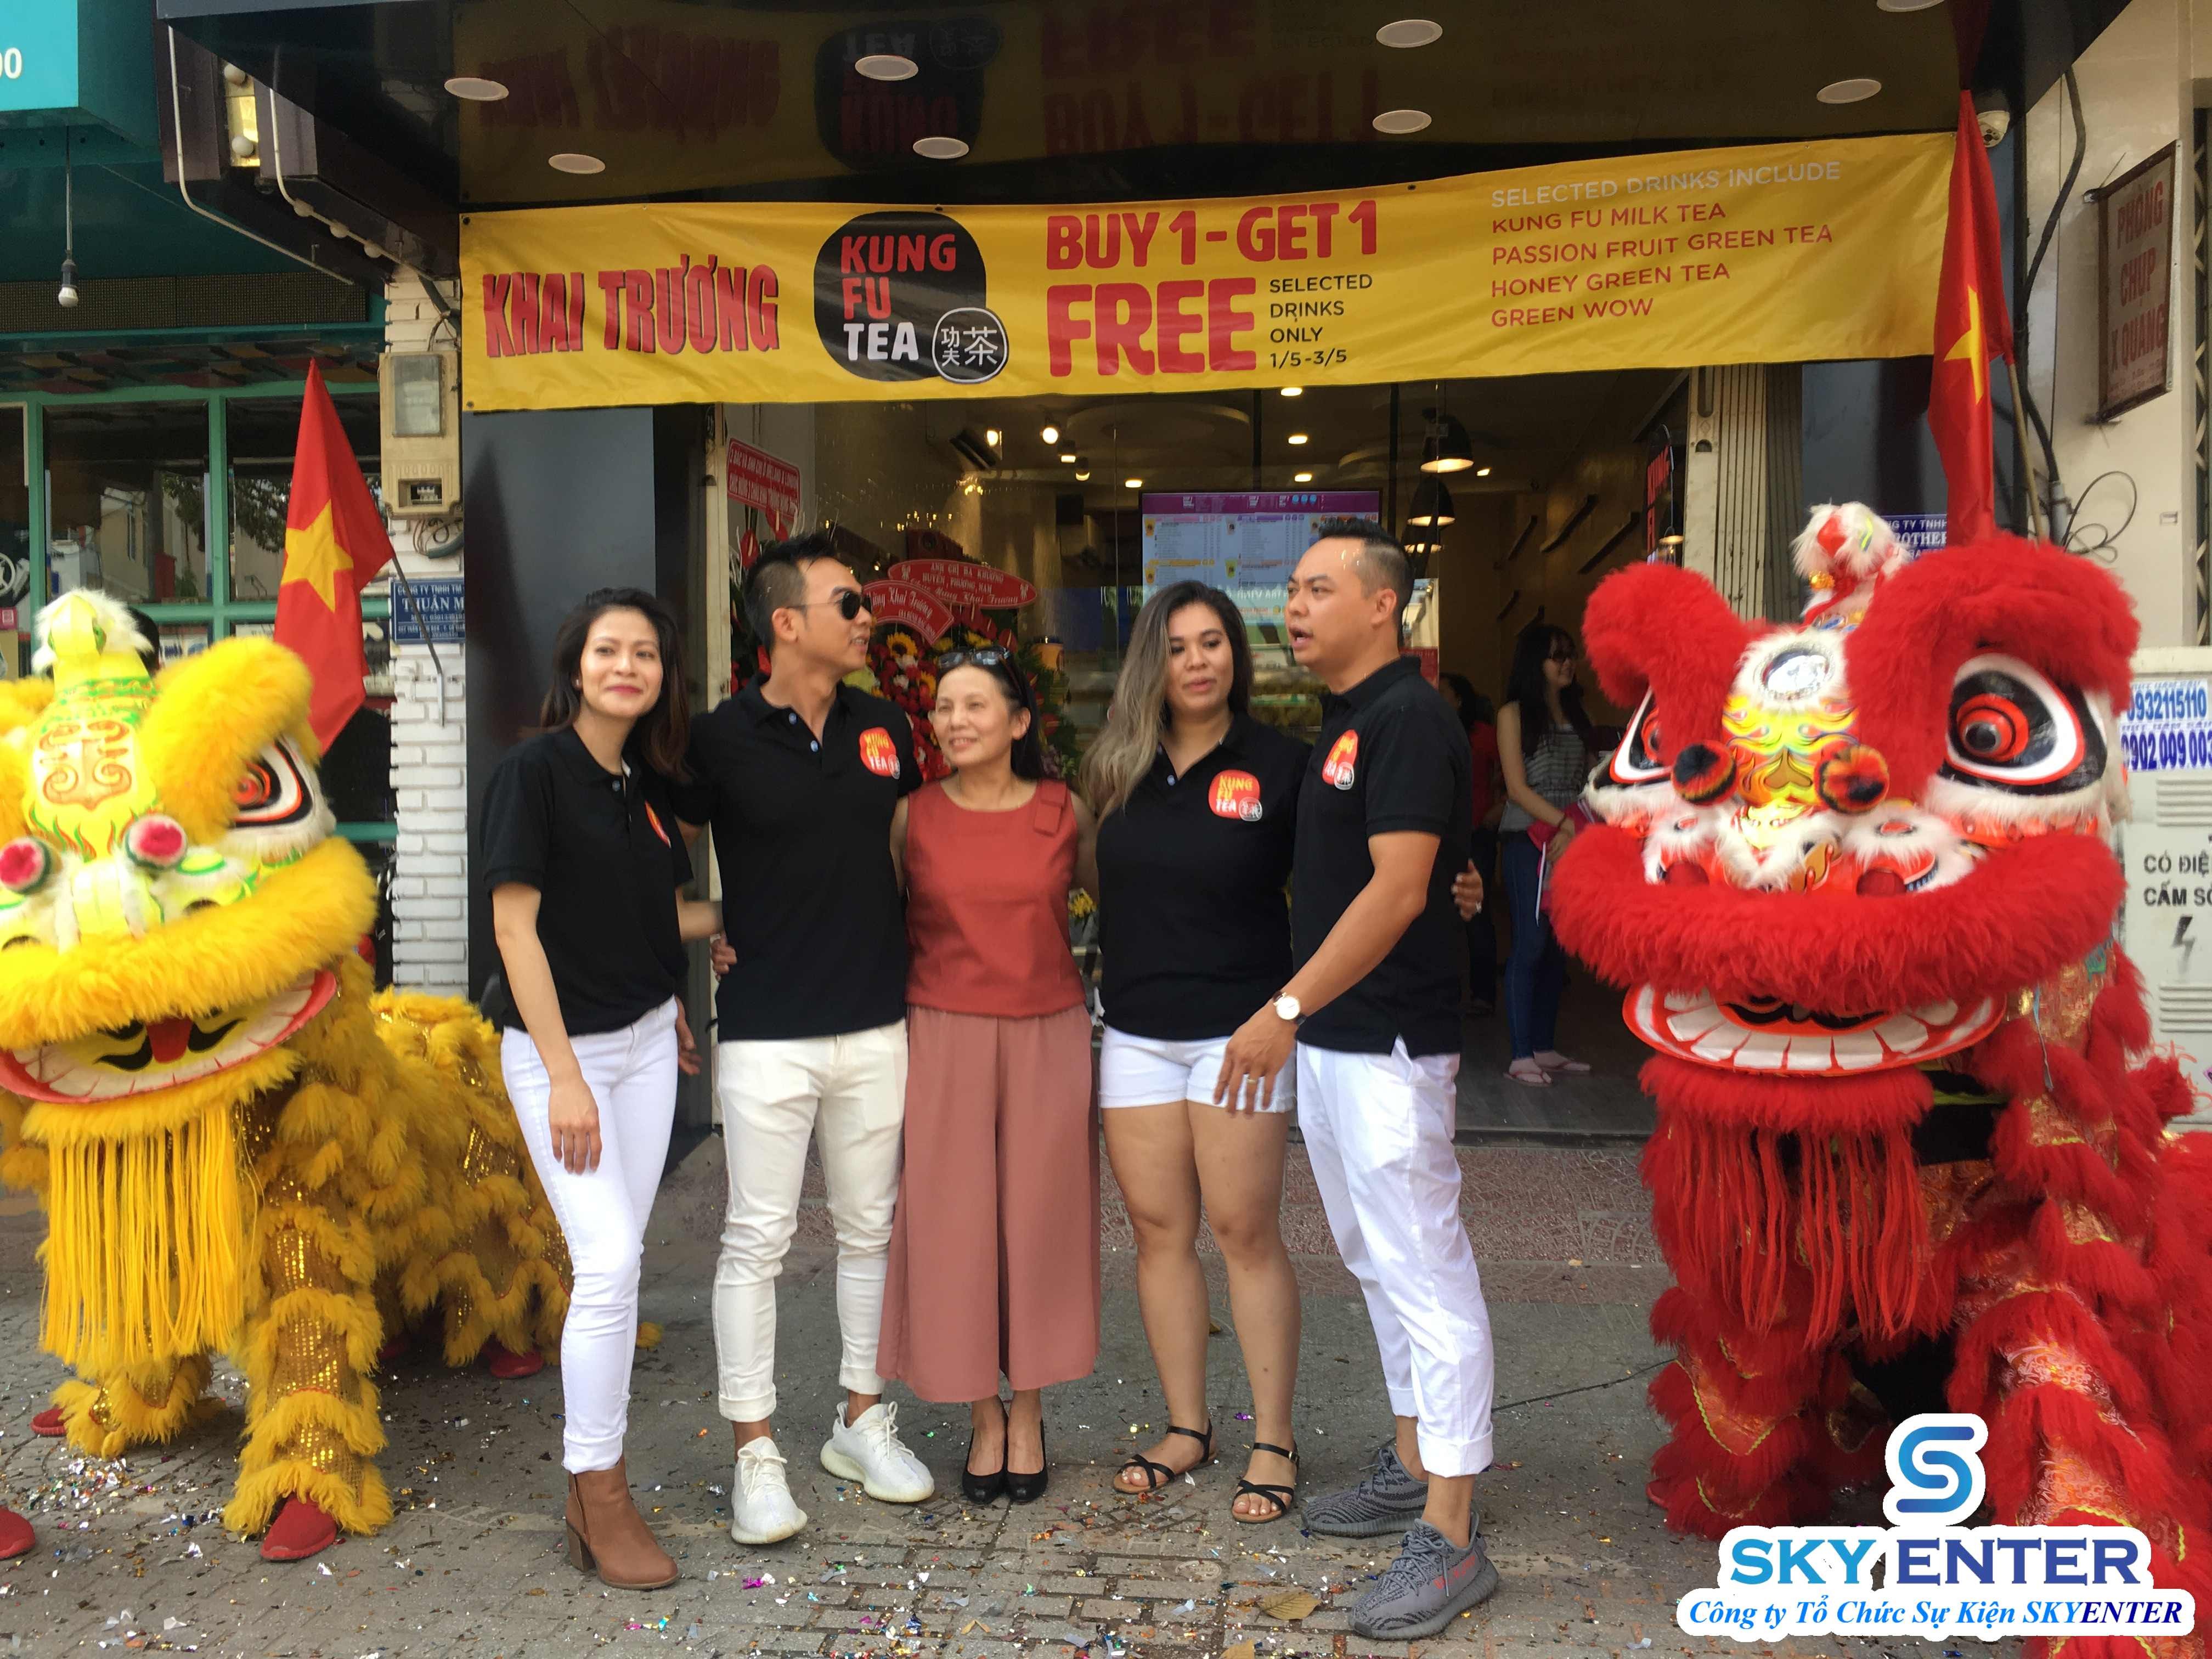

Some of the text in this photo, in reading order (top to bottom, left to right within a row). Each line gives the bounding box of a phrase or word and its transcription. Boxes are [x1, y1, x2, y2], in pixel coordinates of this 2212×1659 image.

[1491, 161, 1841, 208] SELECTED DRINKS INCLUDE
[1492, 202, 1726, 234] KUNG FU MILK TEA
[840, 234, 956, 274] KUNG
[1492, 224, 1833, 266] PASSION FRUIT GREEN TEA
[842, 276, 892, 320] FU
[1269, 273, 1373, 294] SELECTED
[1491, 262, 1730, 298] HONEY GREEN TEA
[483, 254, 780, 358] KHAI TRƯƠNG
[1269, 300, 1345, 320] DRINKS
[1491, 297, 1654, 328] GREEN WOW
[843, 321, 919, 362] TEA
[1046, 277, 1257, 377] FREE
[1269, 326, 1323, 343] ONLY
[1269, 349, 1347, 370] 1/5-3/5
[2143, 849, 2172, 874] CÓ
